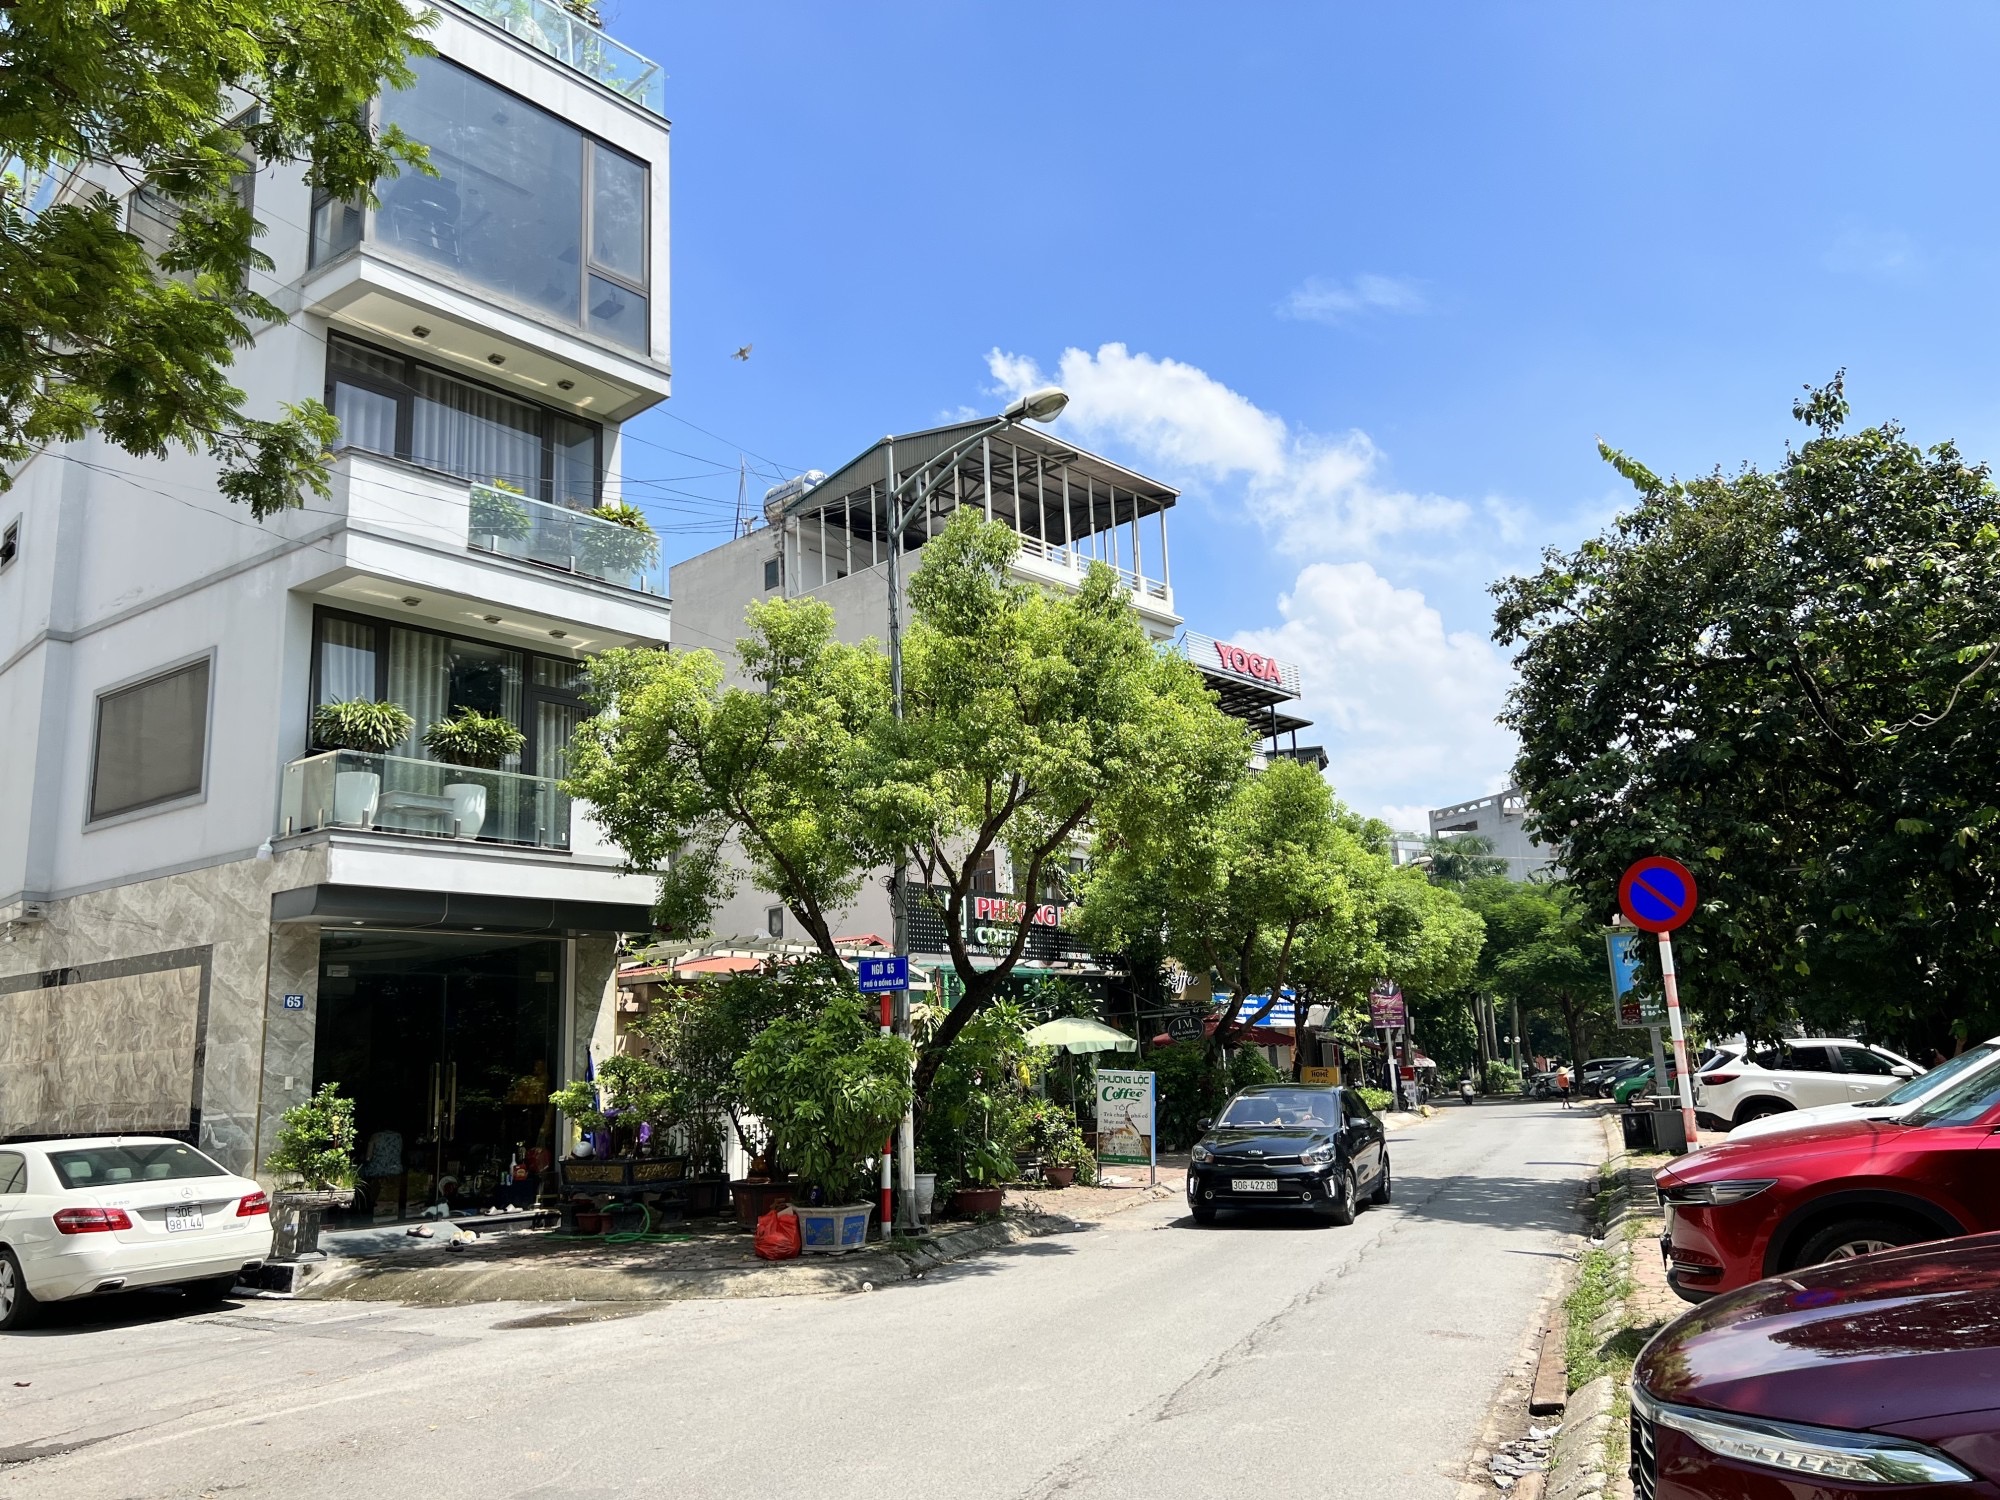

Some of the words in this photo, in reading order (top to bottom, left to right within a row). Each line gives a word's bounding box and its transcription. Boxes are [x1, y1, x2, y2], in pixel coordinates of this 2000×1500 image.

[1213, 641, 1282, 685] YOGA
[975, 926, 1031, 948] COFFE
[886, 963, 895, 974] 65
[286, 996, 301, 1008] 65
[1133, 1075, 1149, 1086] LỘC
[1102, 1086, 1146, 1101] Coffee
[175, 1207, 193, 1218] 30E
